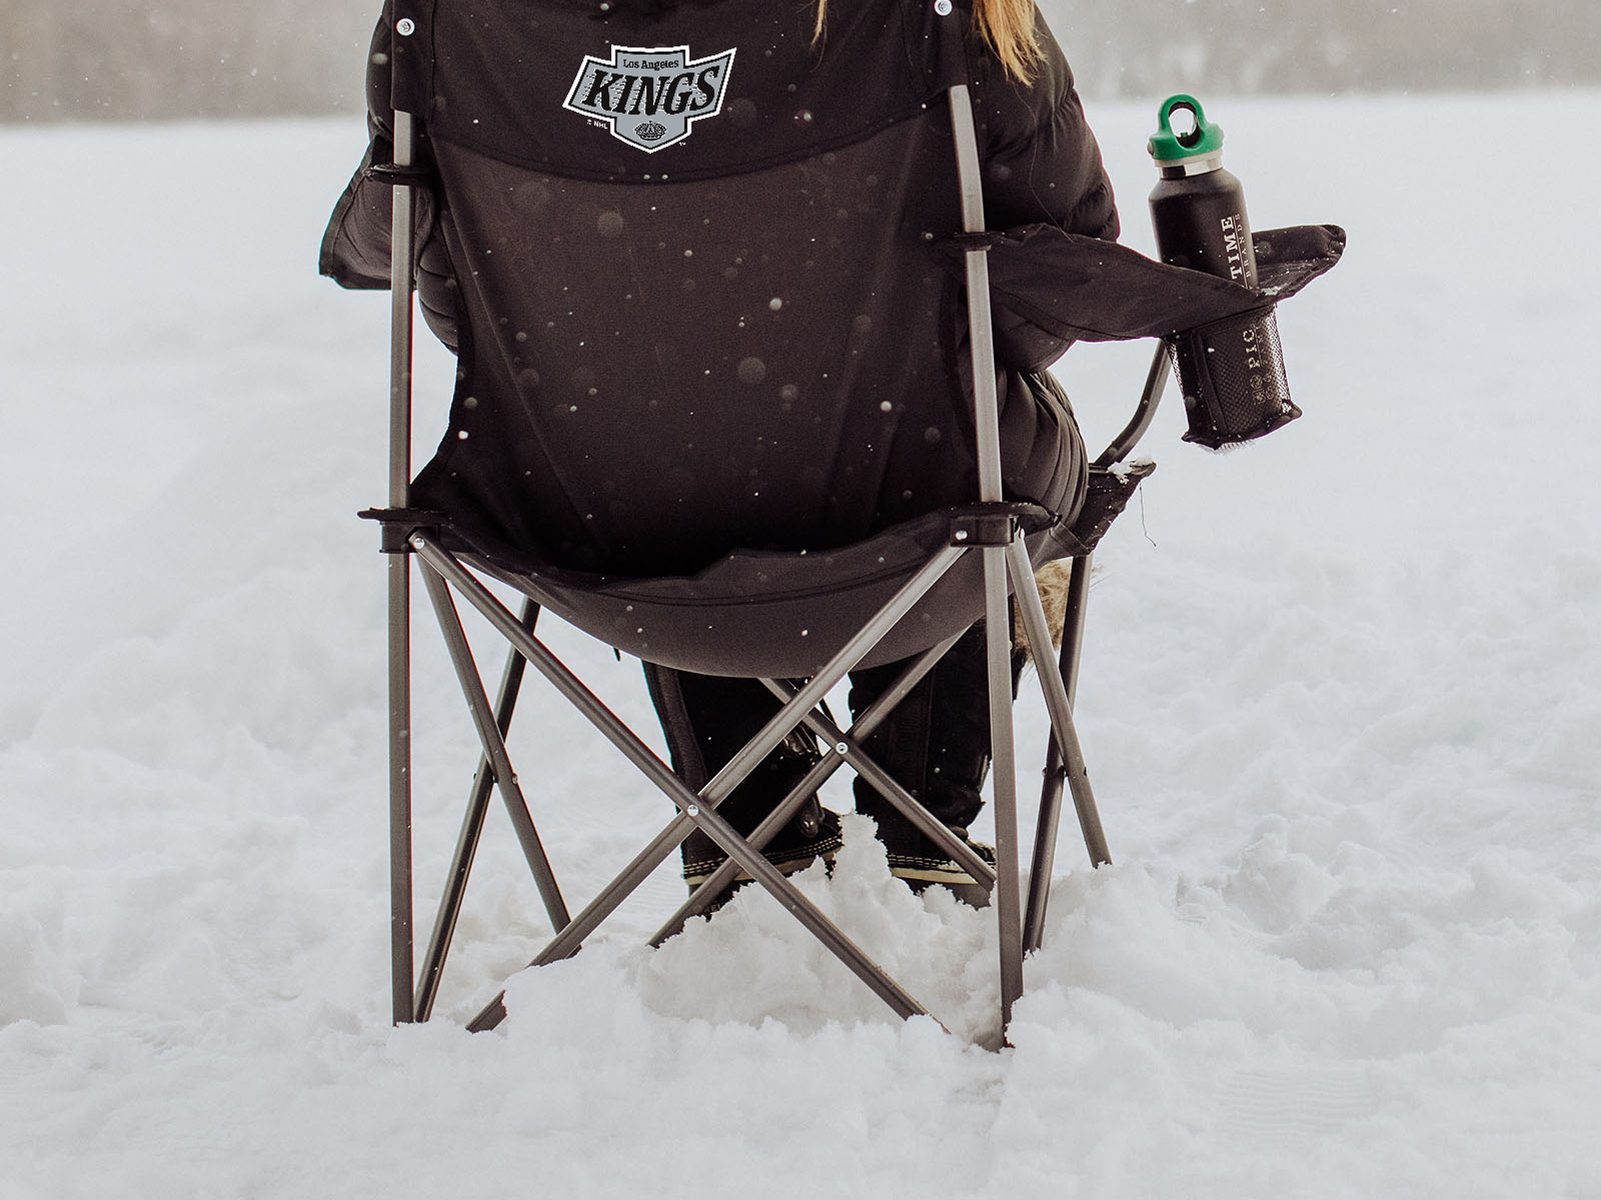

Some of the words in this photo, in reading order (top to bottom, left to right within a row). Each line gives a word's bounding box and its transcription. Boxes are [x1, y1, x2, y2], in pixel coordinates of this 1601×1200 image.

[582, 65, 720, 116] KINGS
[623, 59, 639, 69] Los
[641, 59, 679, 71] Angeles
[593, 121, 608, 130] NHL
[1221, 216, 1243, 280] TIME
[1235, 213, 1252, 278] BRANDS
